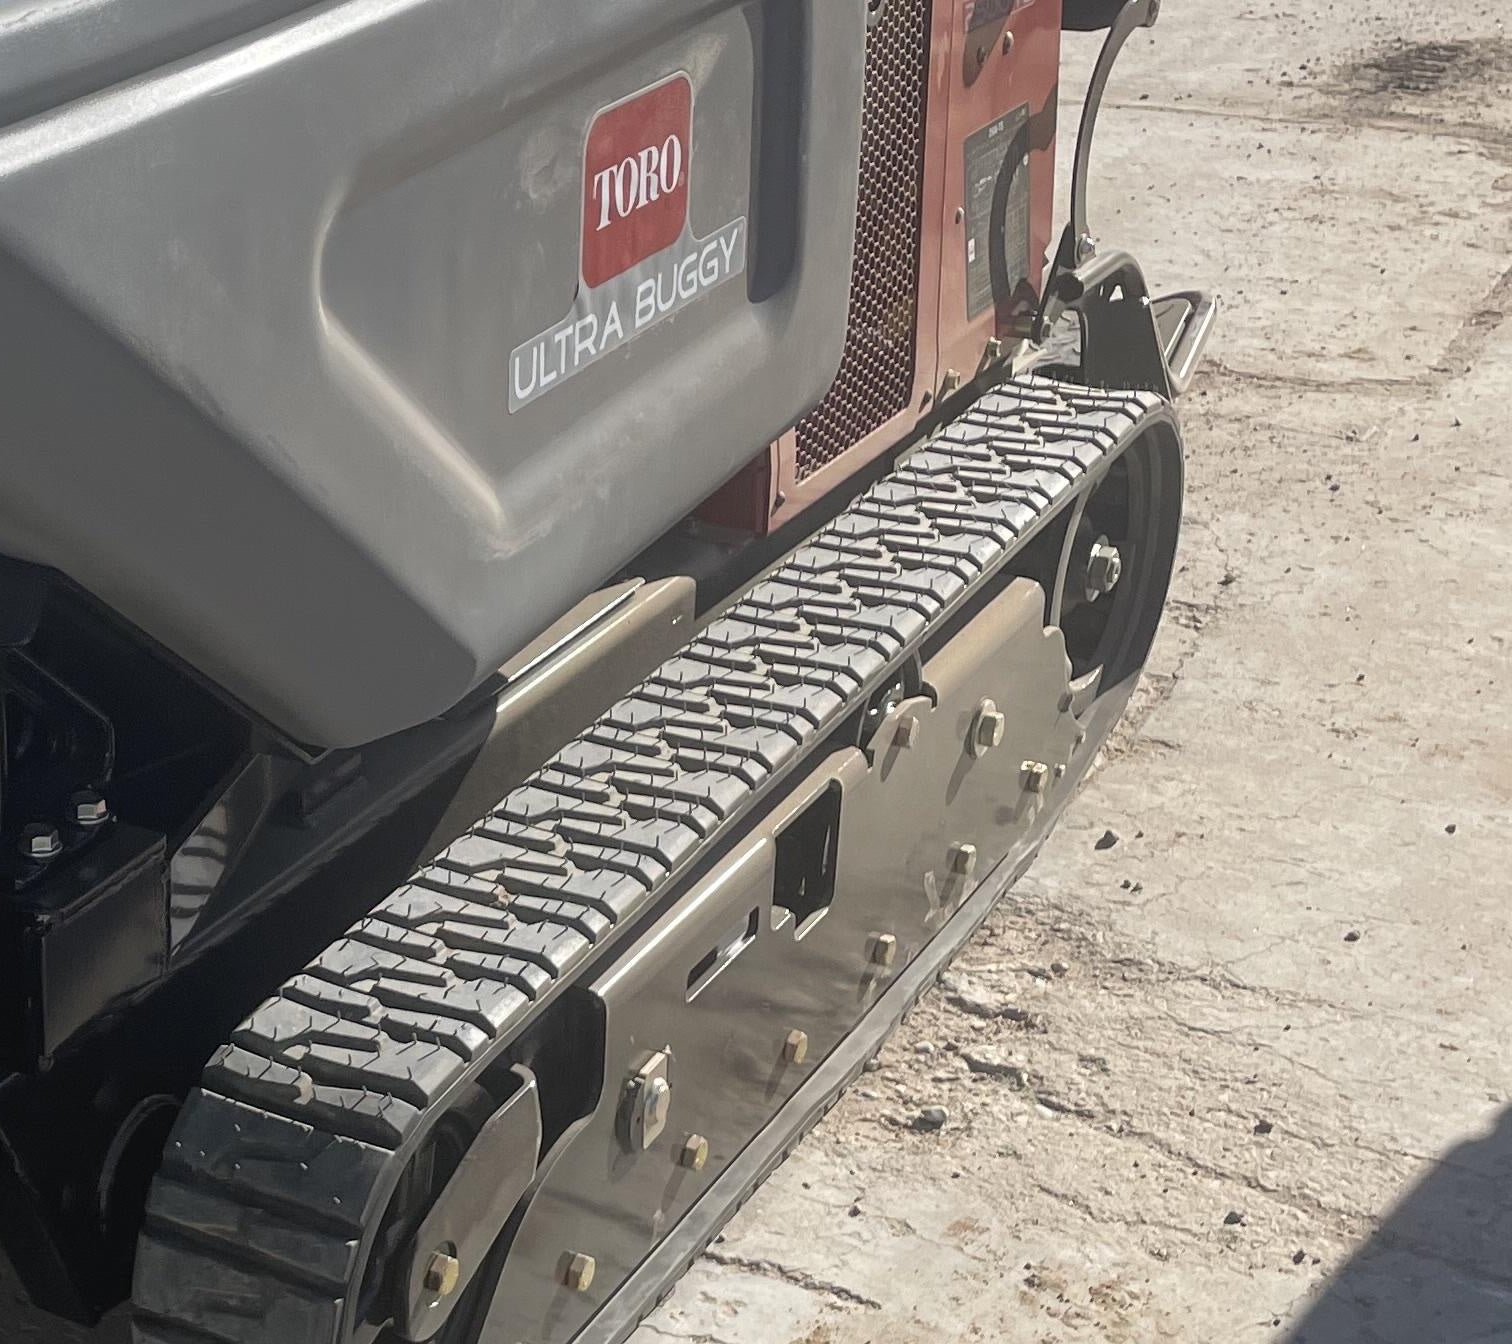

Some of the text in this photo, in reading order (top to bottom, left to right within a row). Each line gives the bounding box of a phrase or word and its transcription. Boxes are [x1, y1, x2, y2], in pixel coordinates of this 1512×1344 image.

[593, 134, 682, 232] TORO
[514, 227, 738, 400] ULTRA BUGGY
